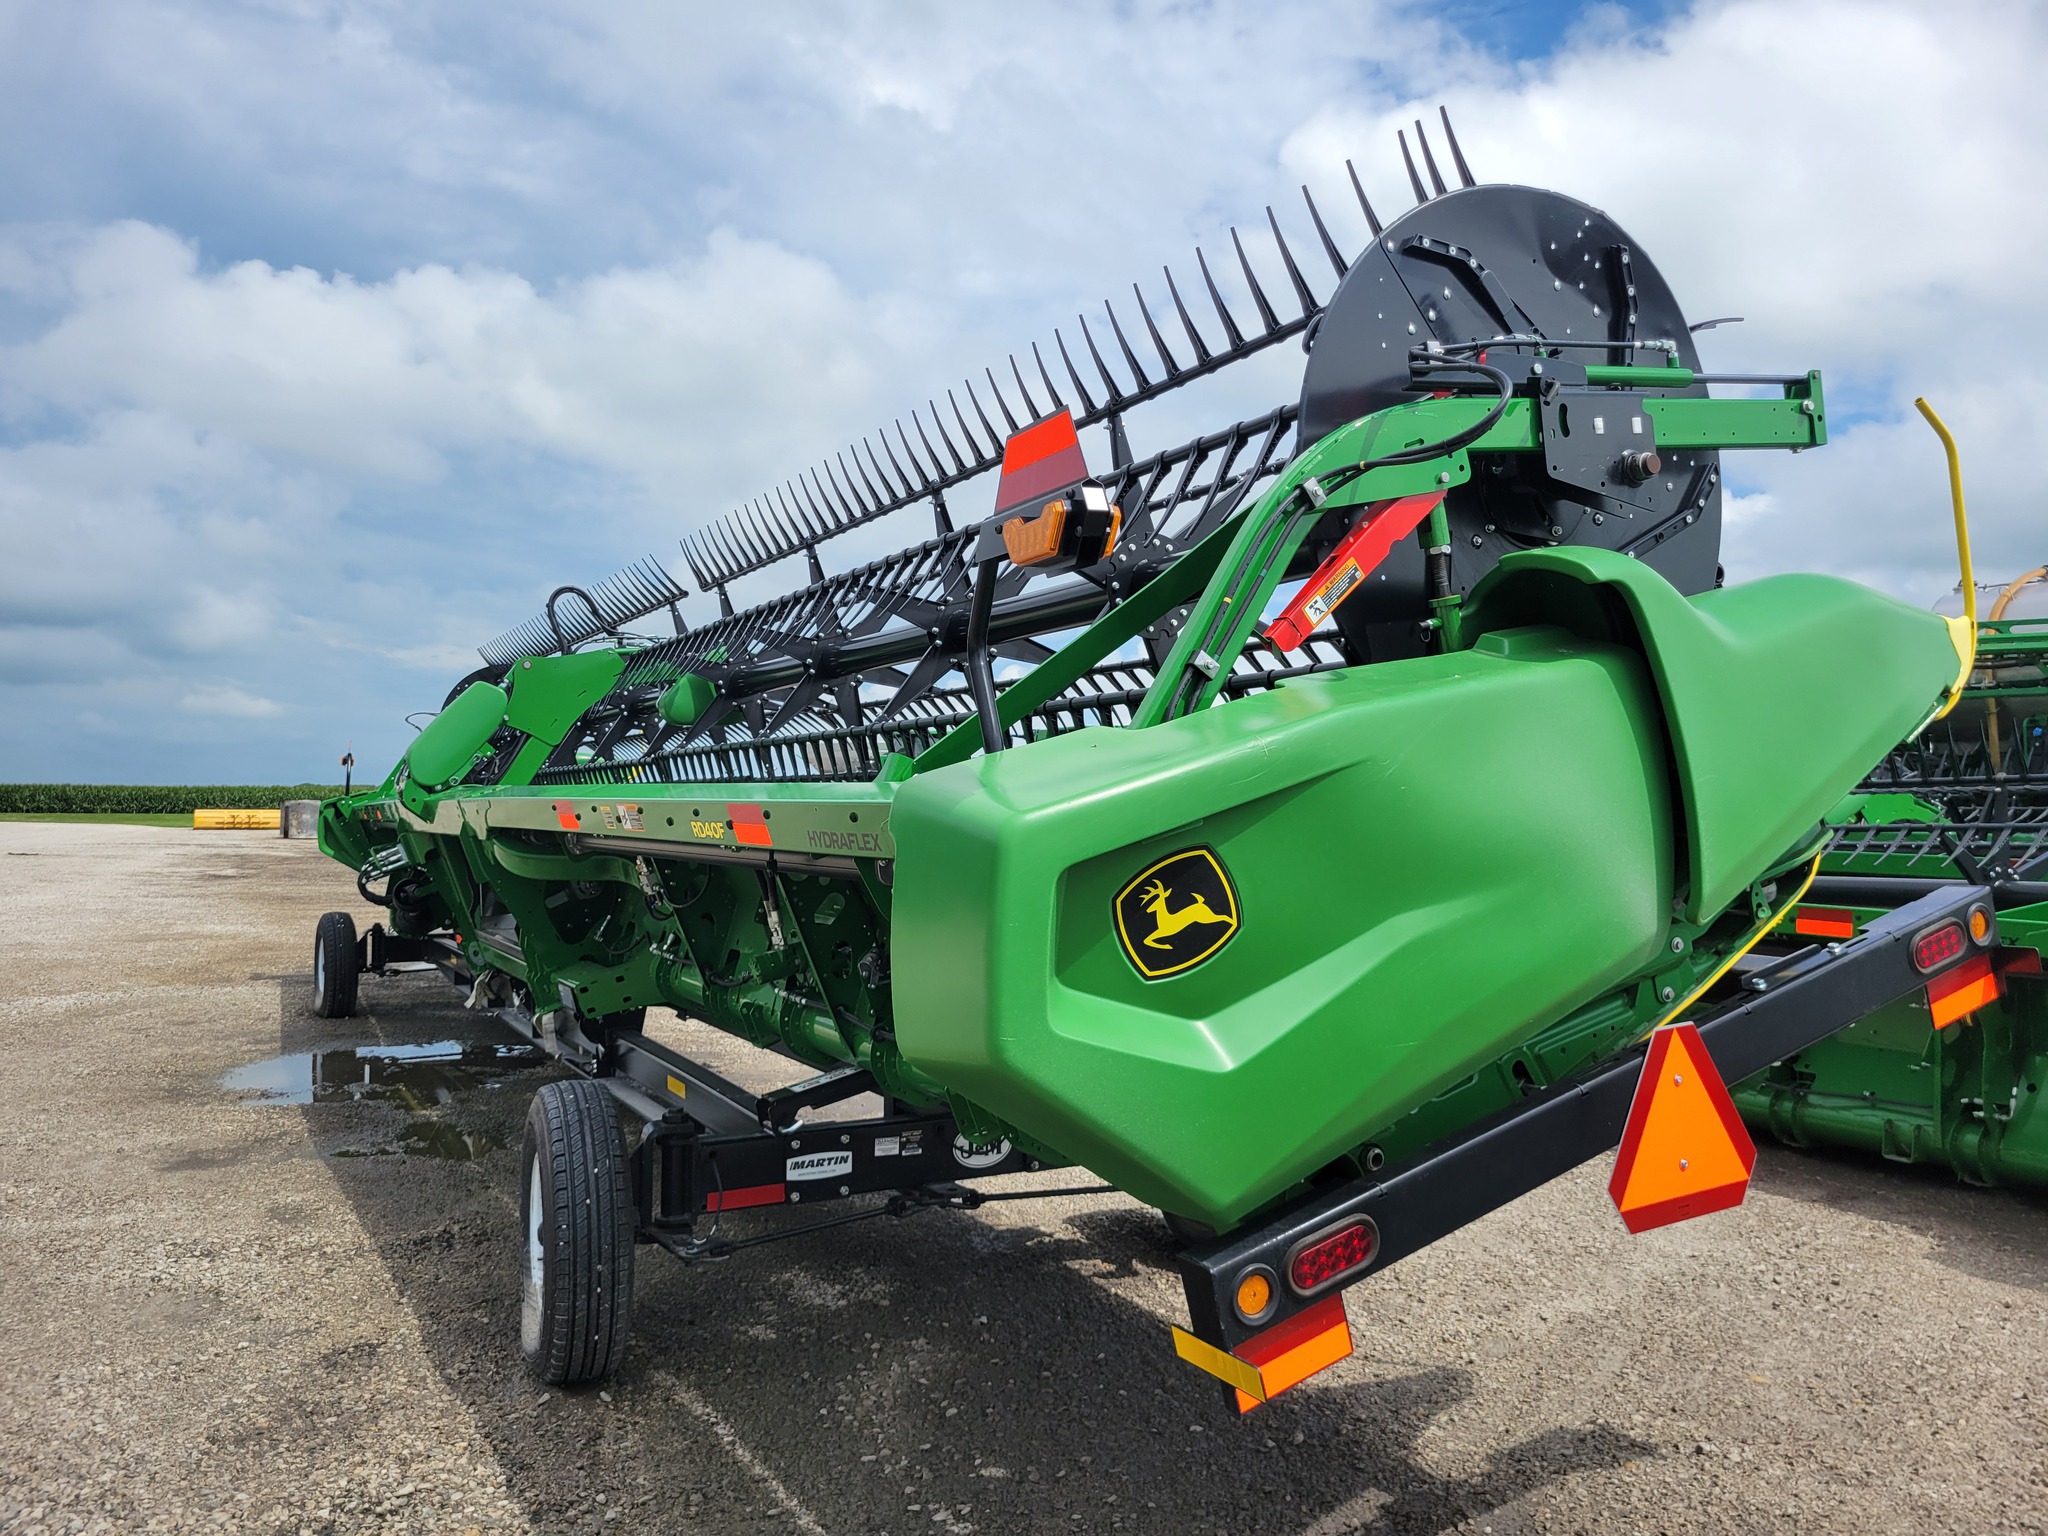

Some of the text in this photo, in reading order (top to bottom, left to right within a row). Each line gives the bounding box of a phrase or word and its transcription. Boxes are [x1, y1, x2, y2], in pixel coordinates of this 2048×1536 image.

[1329, 564, 1350, 585] WARNING
[690, 821, 725, 839] RD40F
[807, 830, 883, 852] HYDRAFLEX
[789, 1154, 850, 1171] MARTIN
